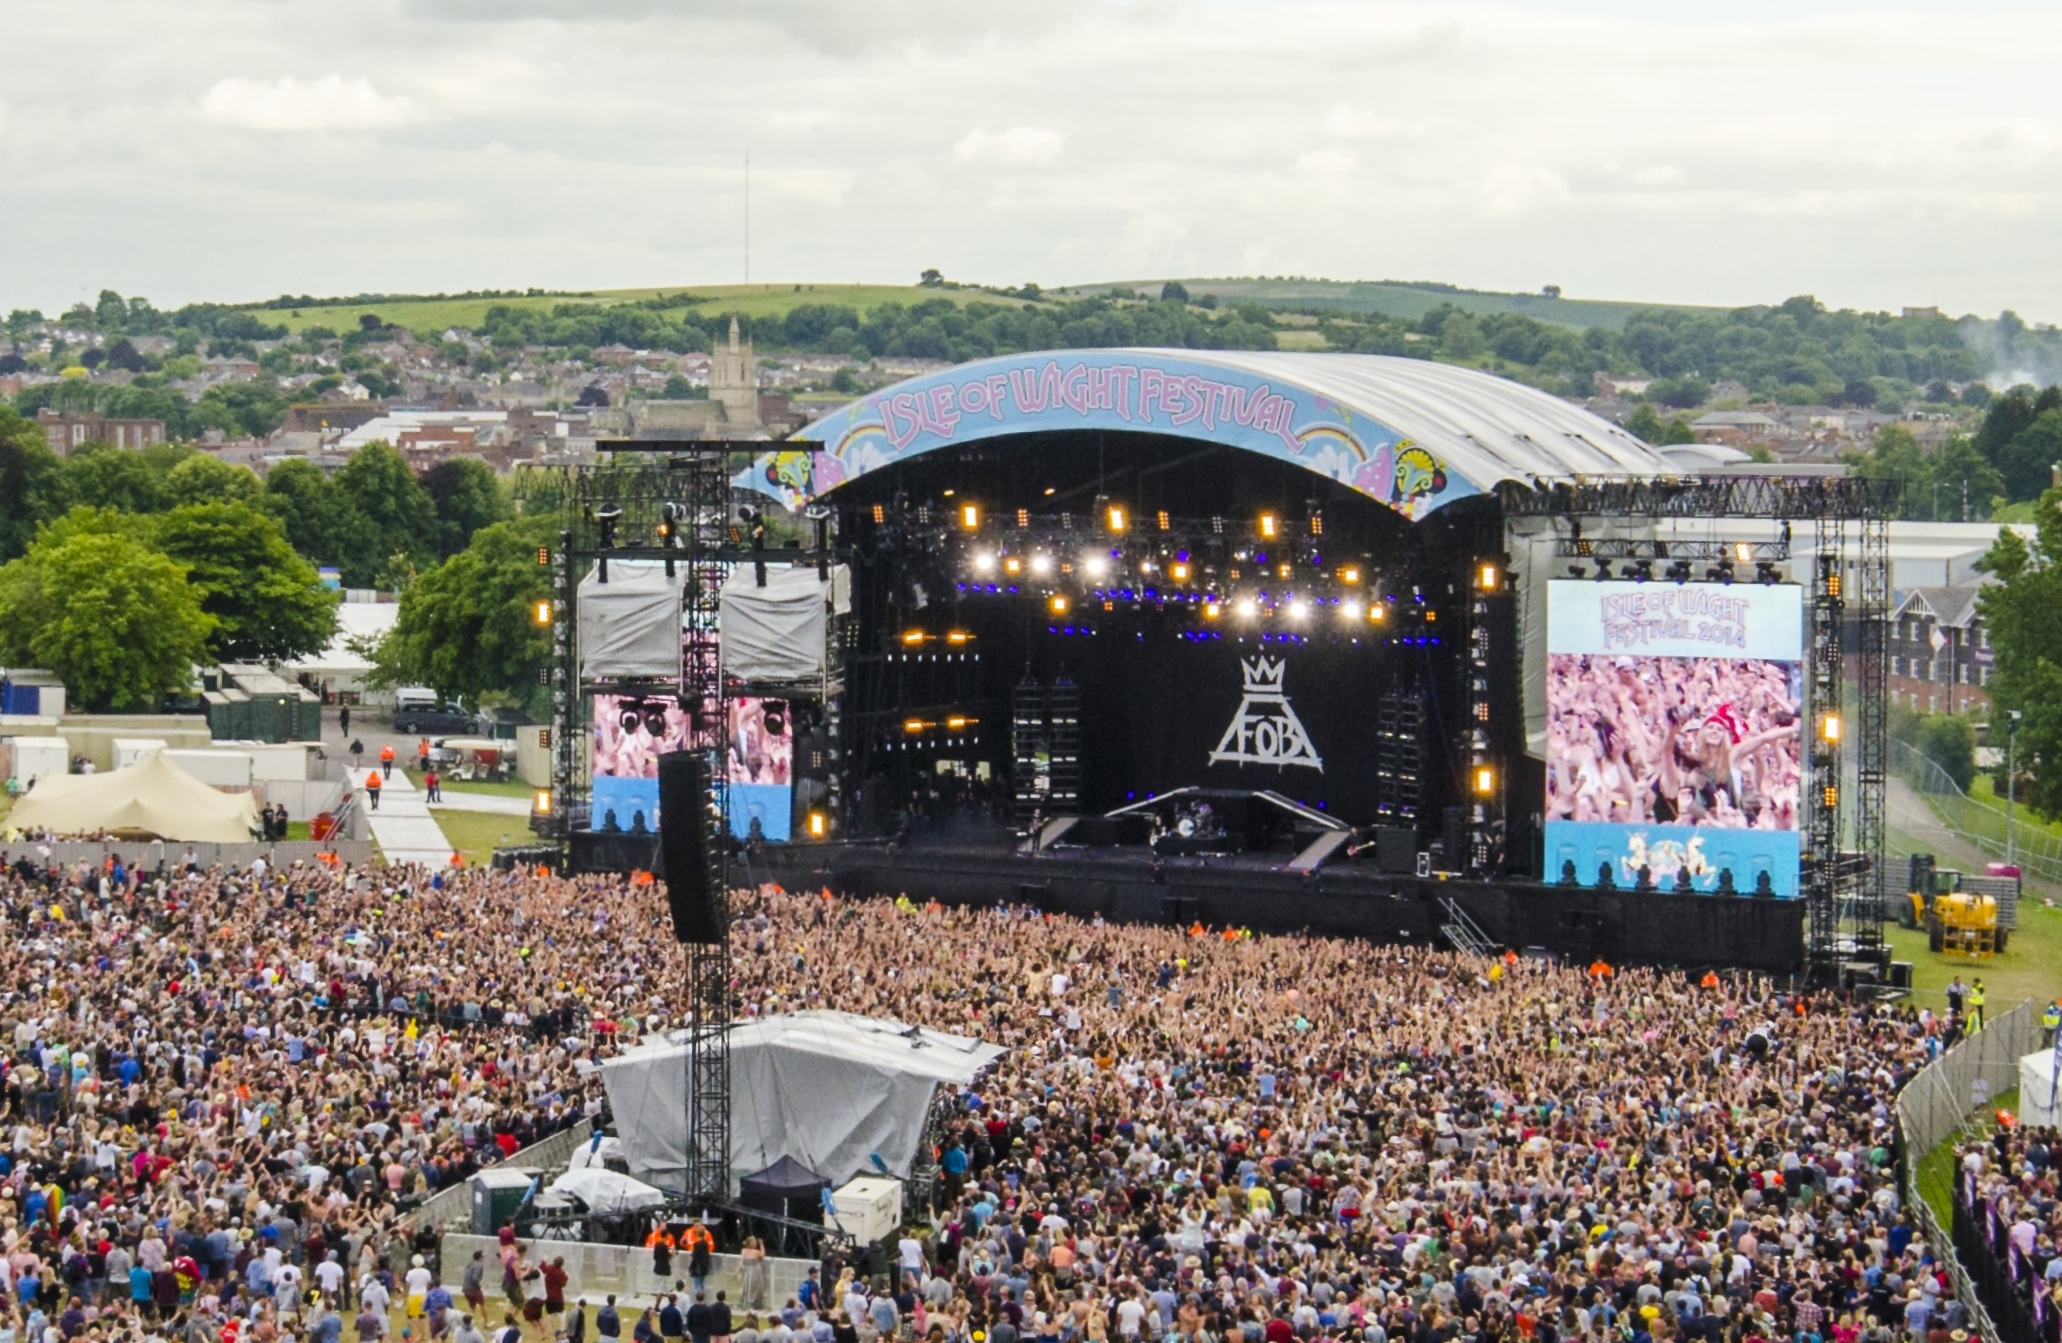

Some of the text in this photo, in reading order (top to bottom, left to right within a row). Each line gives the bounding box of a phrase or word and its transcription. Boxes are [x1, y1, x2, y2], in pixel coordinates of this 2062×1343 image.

[878, 361, 1306, 454] ISLE OF WIGHT FESTIVAL
[1601, 589, 1750, 629] ISLE OF WIGHT
[1604, 618, 1746, 649] FESTIVAL 2014
[1236, 714, 1302, 767] FOB
